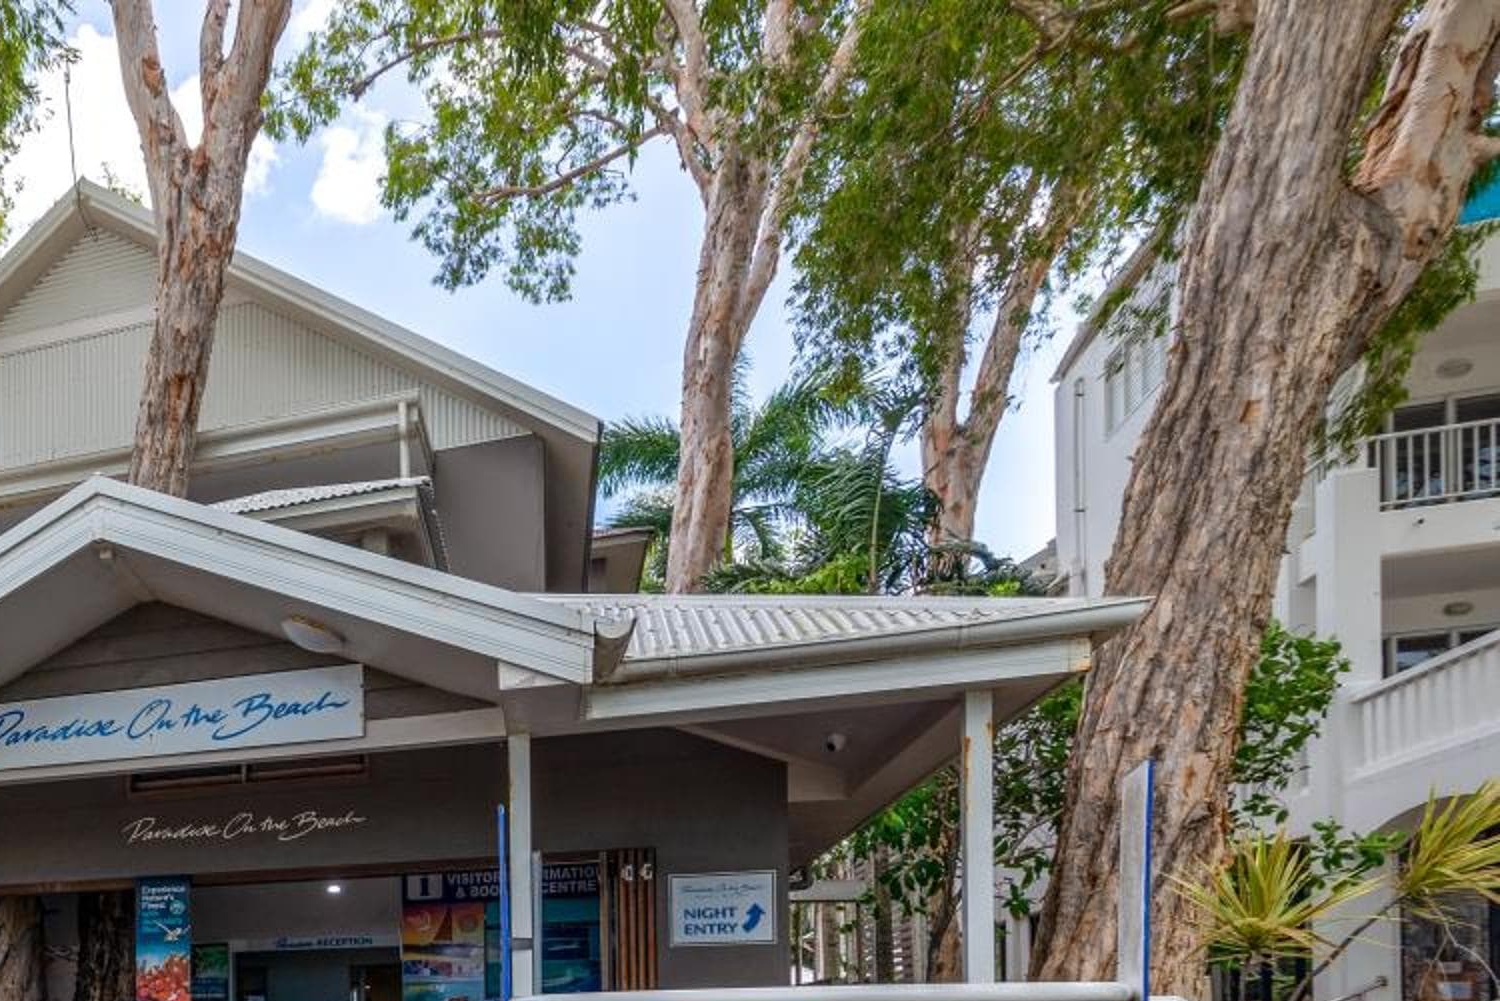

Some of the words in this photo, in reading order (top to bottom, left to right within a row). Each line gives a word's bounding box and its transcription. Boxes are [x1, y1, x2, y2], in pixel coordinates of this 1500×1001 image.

[127, 699, 177, 740] On
[179, 708, 228, 728] the
[212, 691, 351, 741] Beach
[121, 817, 222, 844] Paradise
[223, 813, 257, 839] On
[260, 815, 291, 832] the
[278, 811, 367, 841] Beach
[684, 906, 738, 919] NIGHT
[684, 922, 738, 935] ENTRY
